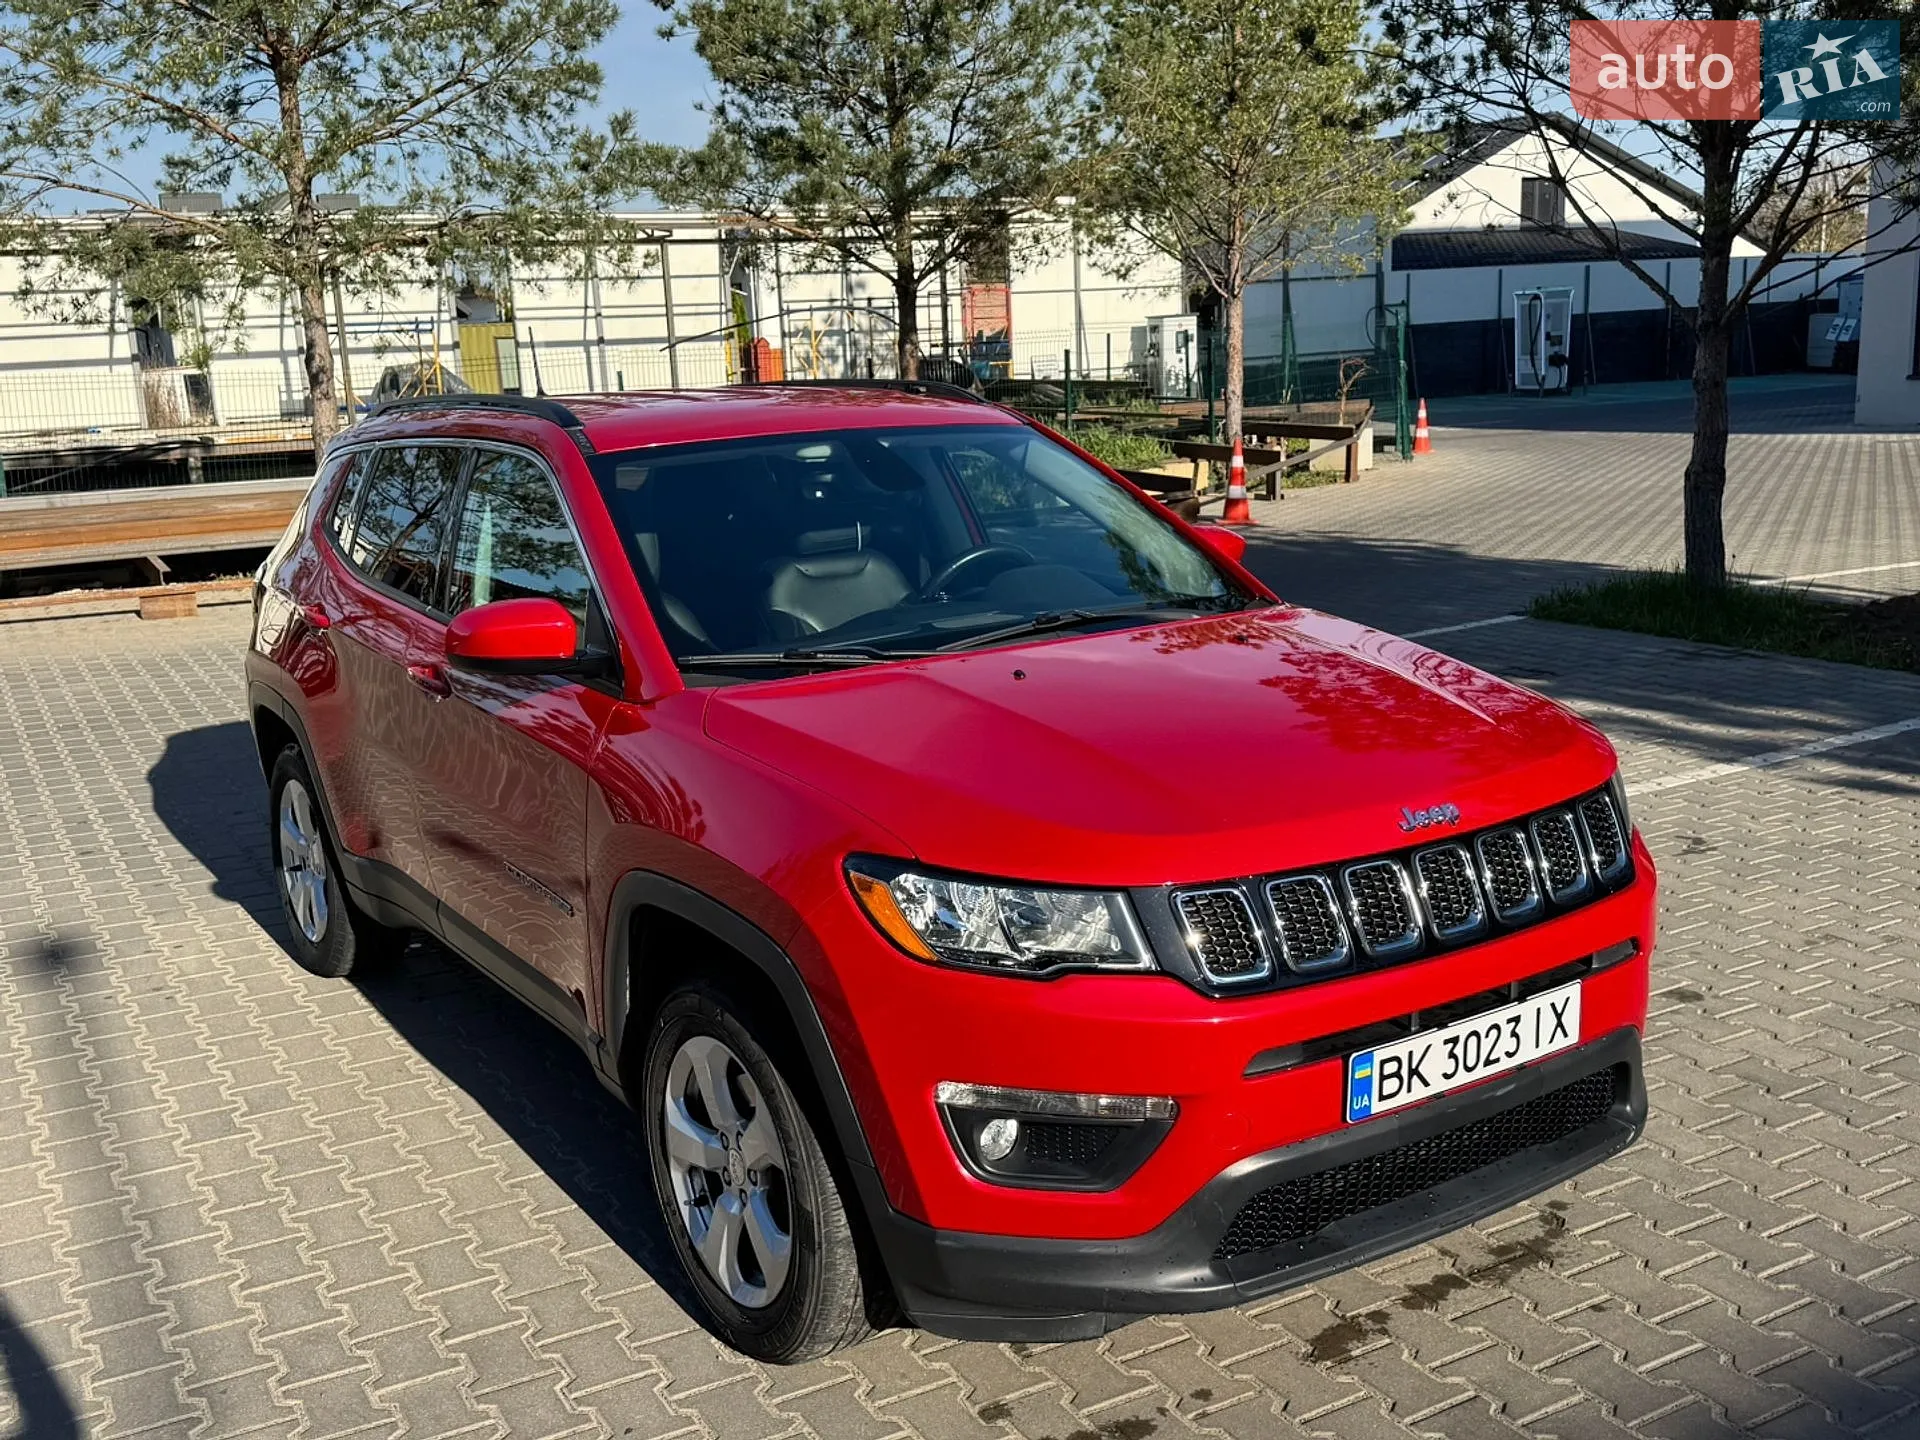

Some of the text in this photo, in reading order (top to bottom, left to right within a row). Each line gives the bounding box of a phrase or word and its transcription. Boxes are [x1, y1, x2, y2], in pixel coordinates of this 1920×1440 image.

[1399, 802, 1460, 831] Jeep
[1377, 996, 1571, 1103] BK 3023 IX
[1353, 1095, 1370, 1110] UA
